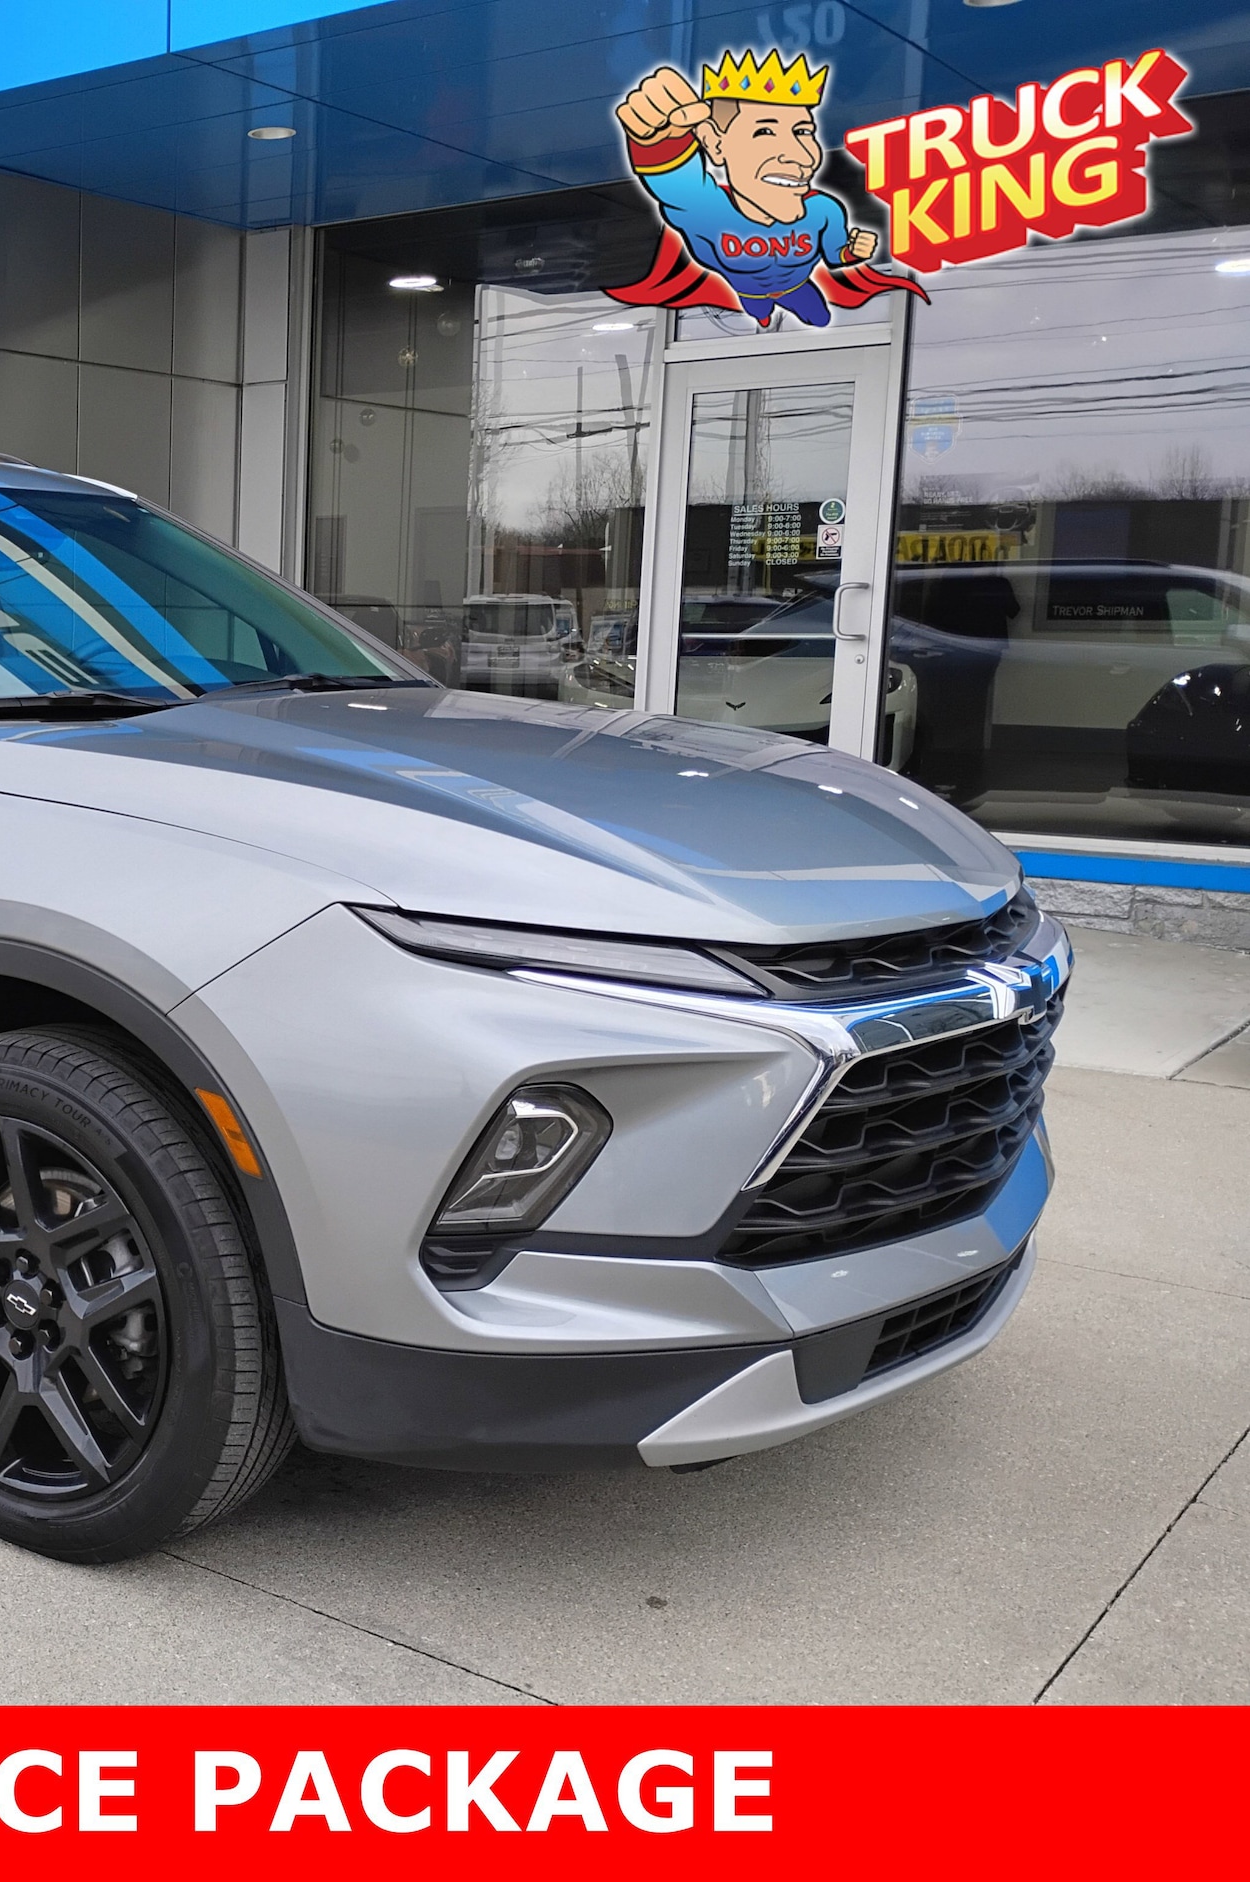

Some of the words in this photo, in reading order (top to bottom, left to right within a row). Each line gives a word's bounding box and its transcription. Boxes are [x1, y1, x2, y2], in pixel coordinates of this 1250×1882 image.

[733, 504, 764, 513] SALES
[766, 503, 800, 512] HOURS
[730, 523, 756, 531] Tuesday
[729, 530, 766, 538] Wednesday
[729, 538, 758, 546] Thursday
[729, 545, 749, 553] Friday
[728, 552, 756, 560] Saturday
[1052, 604, 1094, 616] TREVOR
[1096, 604, 1144, 616] SHIPMAN
[53, 1097, 92, 1128] TOUR
